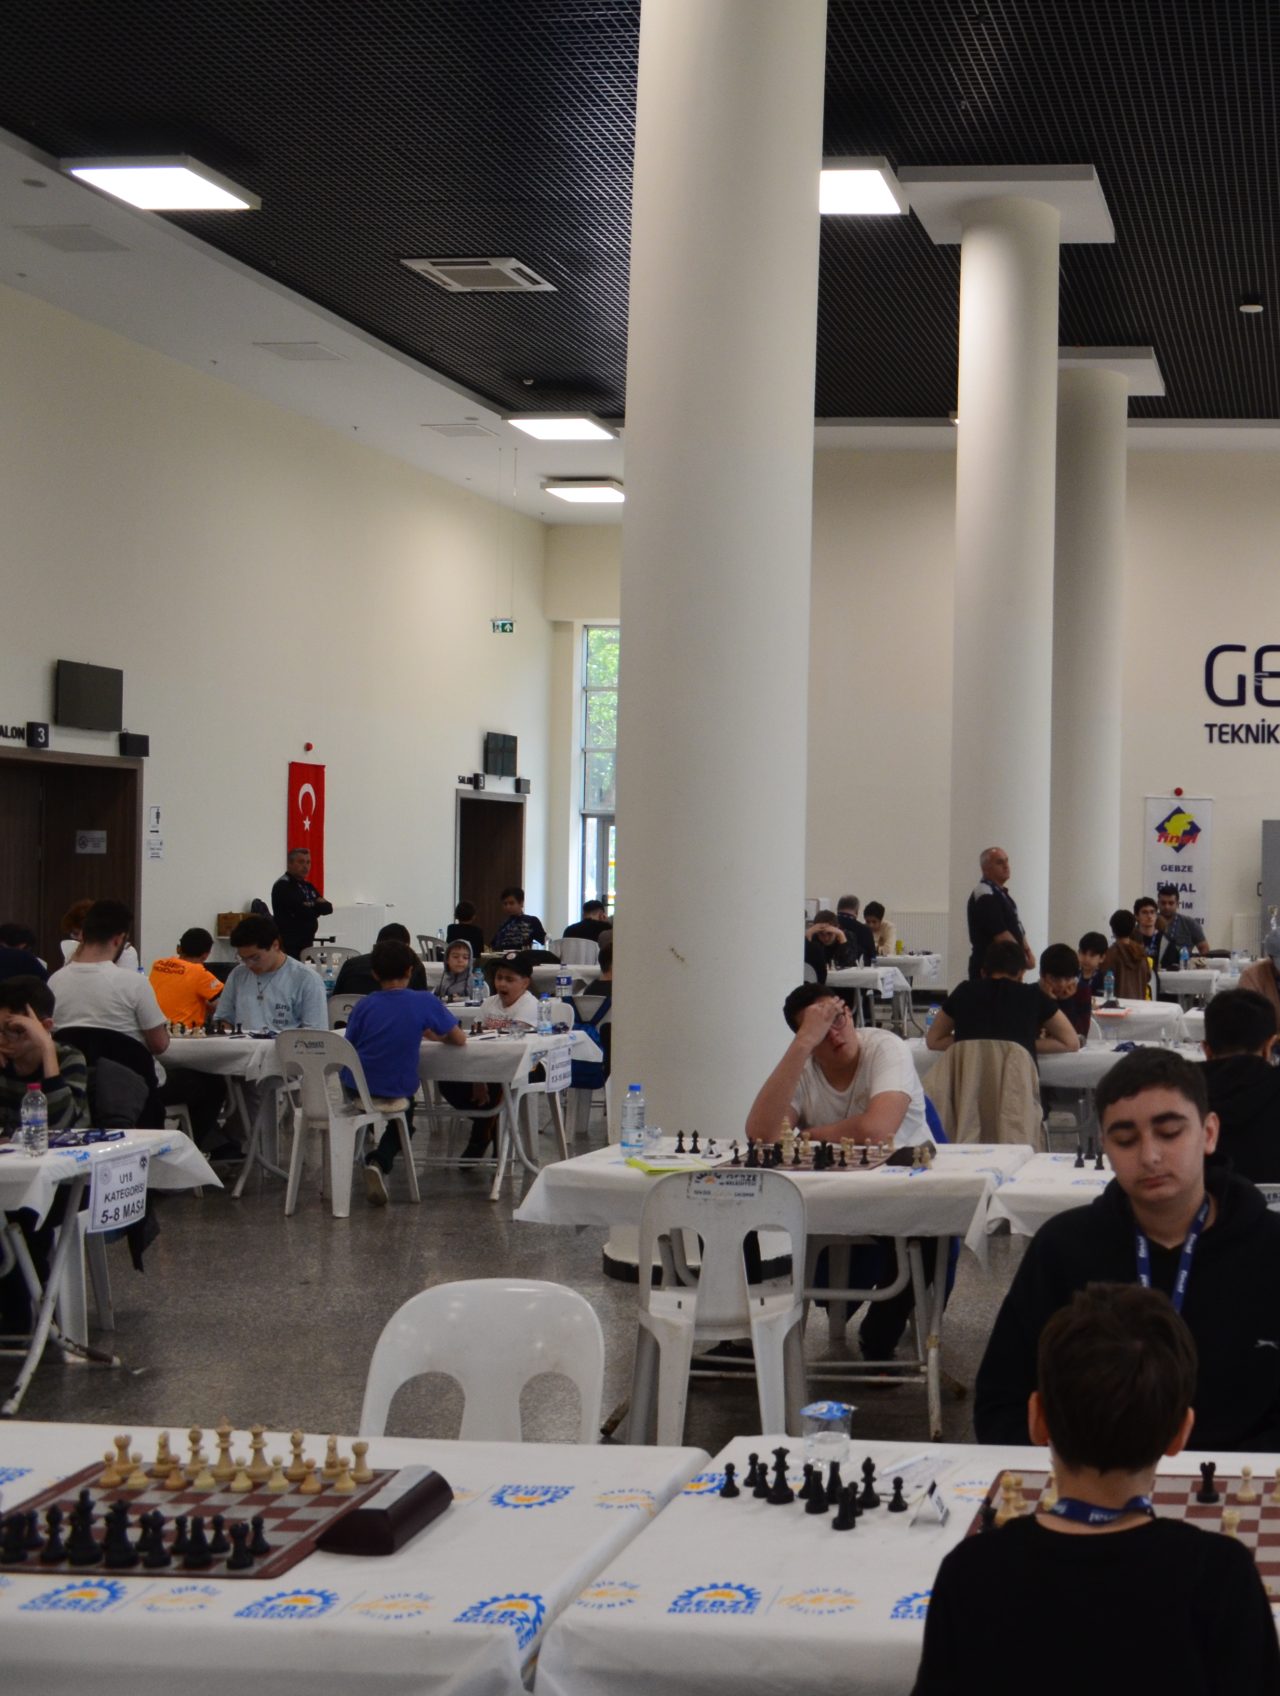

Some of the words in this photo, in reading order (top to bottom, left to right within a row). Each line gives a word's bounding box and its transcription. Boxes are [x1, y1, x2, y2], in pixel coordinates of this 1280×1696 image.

[38, 727, 46, 743] 3
[1204, 719, 1280, 744] TEKNİK
[1161, 864, 1193, 872] GEBZE
[119, 1171, 133, 1184] U18
[101, 1207, 120, 1223] 5-8
